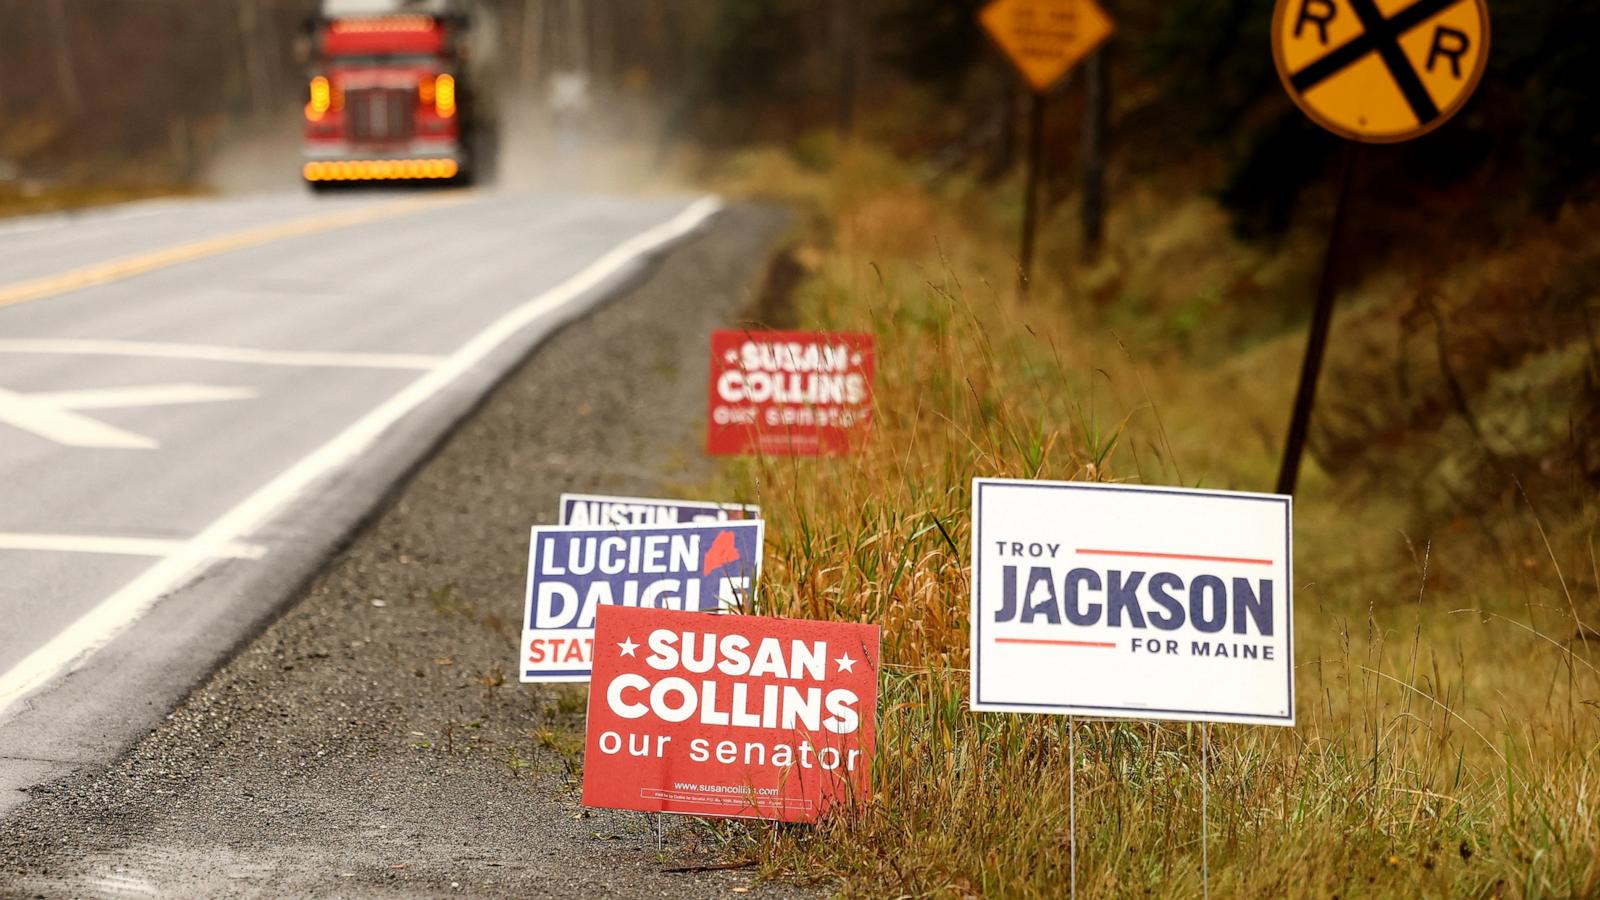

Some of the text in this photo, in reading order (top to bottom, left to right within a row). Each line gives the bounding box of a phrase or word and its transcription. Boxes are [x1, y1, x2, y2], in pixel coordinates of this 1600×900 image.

[1294, 0, 1471, 79] R R
[741, 340, 848, 374] SUSAN
[716, 369, 864, 404] COLLINS
[569, 500, 679, 527] AUSTIN
[541, 534, 701, 575] LUCIEN
[996, 541, 1061, 558] TROY
[995, 565, 1274, 636] JACKSON
[645, 629, 828, 681] SUSAN
[1131, 638, 1275, 661] FOR MAINE
[606, 673, 859, 734] COLLINS
[599, 731, 862, 772] our senator
